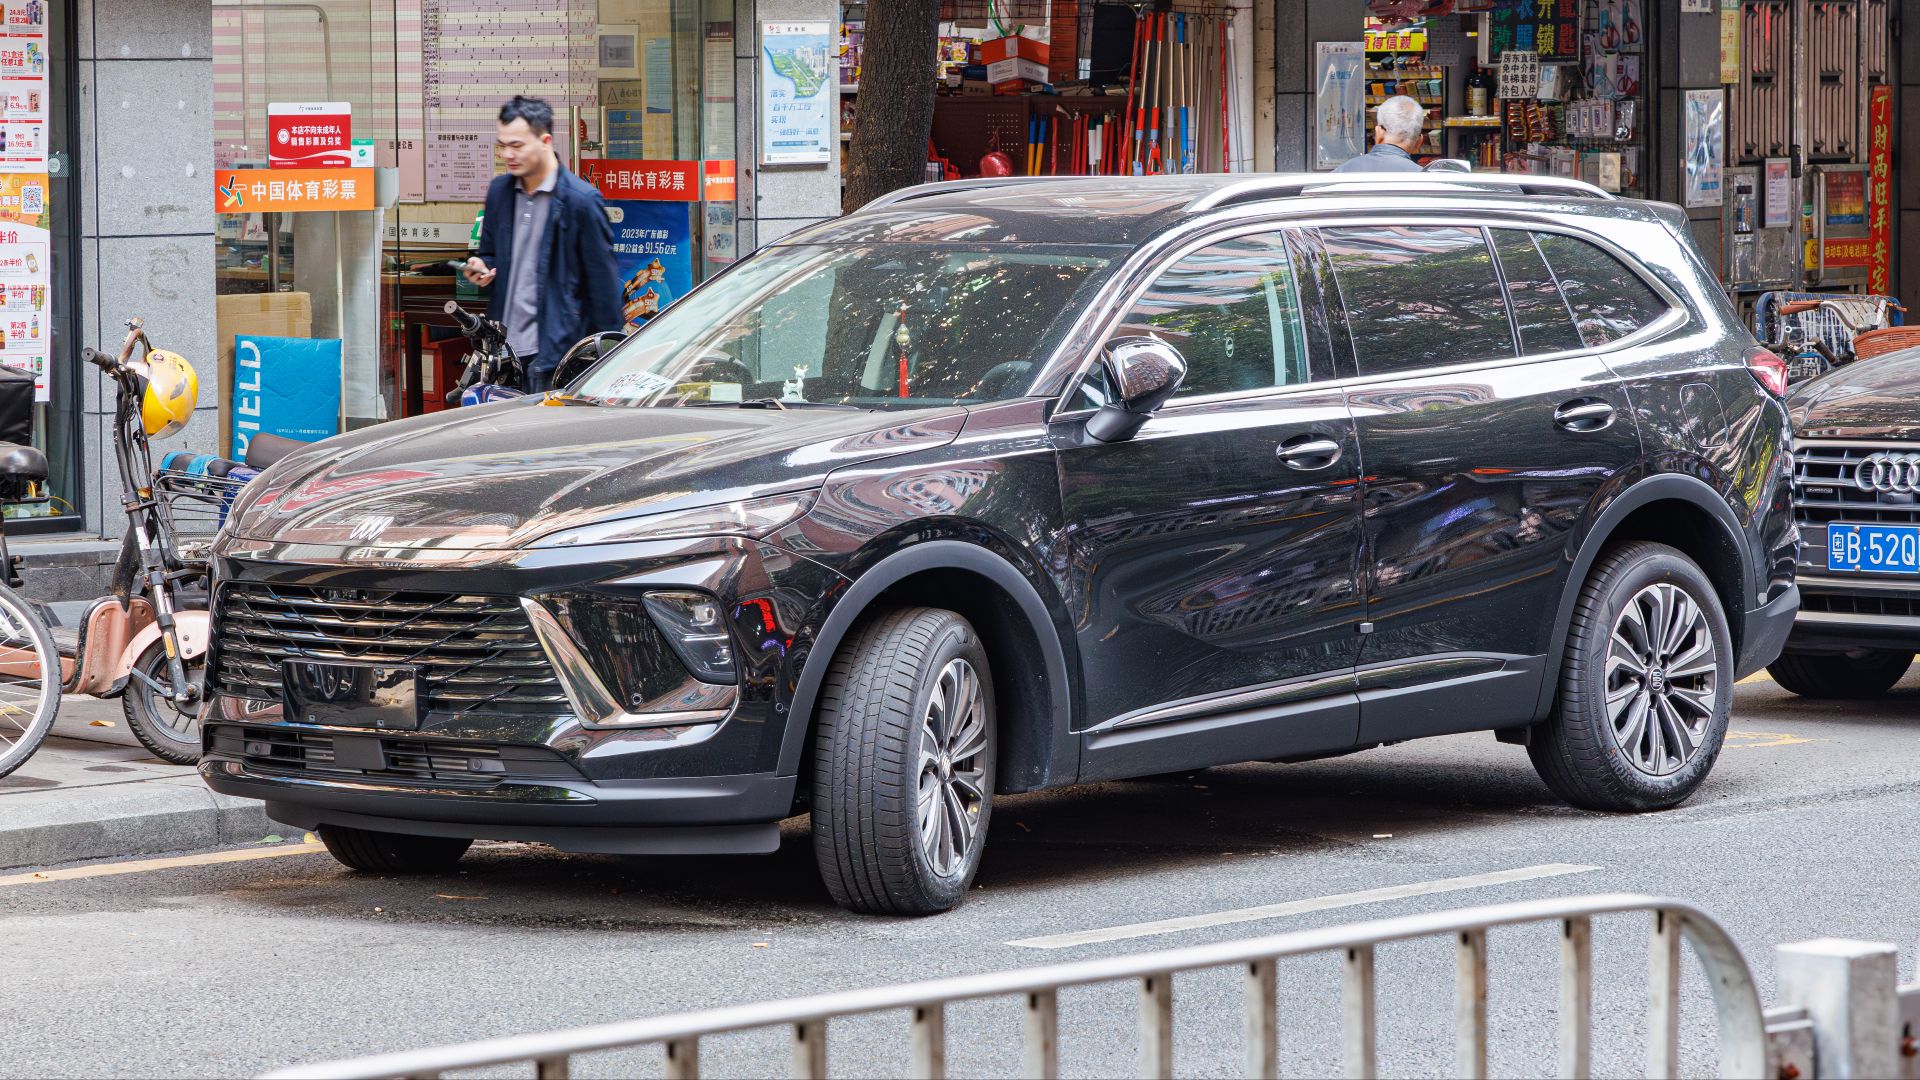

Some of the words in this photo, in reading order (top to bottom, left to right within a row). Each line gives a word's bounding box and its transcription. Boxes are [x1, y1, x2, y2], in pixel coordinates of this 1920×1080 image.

[1503, 53, 1537, 63] 房东直租
[1502, 64, 1537, 72] 免中介费
[1502, 74, 1536, 84] 电梯套房
[1502, 85, 1536, 96] 拎包入住
[291, 125, 341, 135] 本店不向未成年人
[290, 136, 341, 146] 销售彩票及兑奖
[605, 170, 686, 191] 中国体育彩票
[251, 179, 357, 202] 中国体育彩票
[11, 291, 25, 299] 半价
[11, 329, 26, 339] 半价
[1832, 532, 1920, 566] 粤B·52Q
